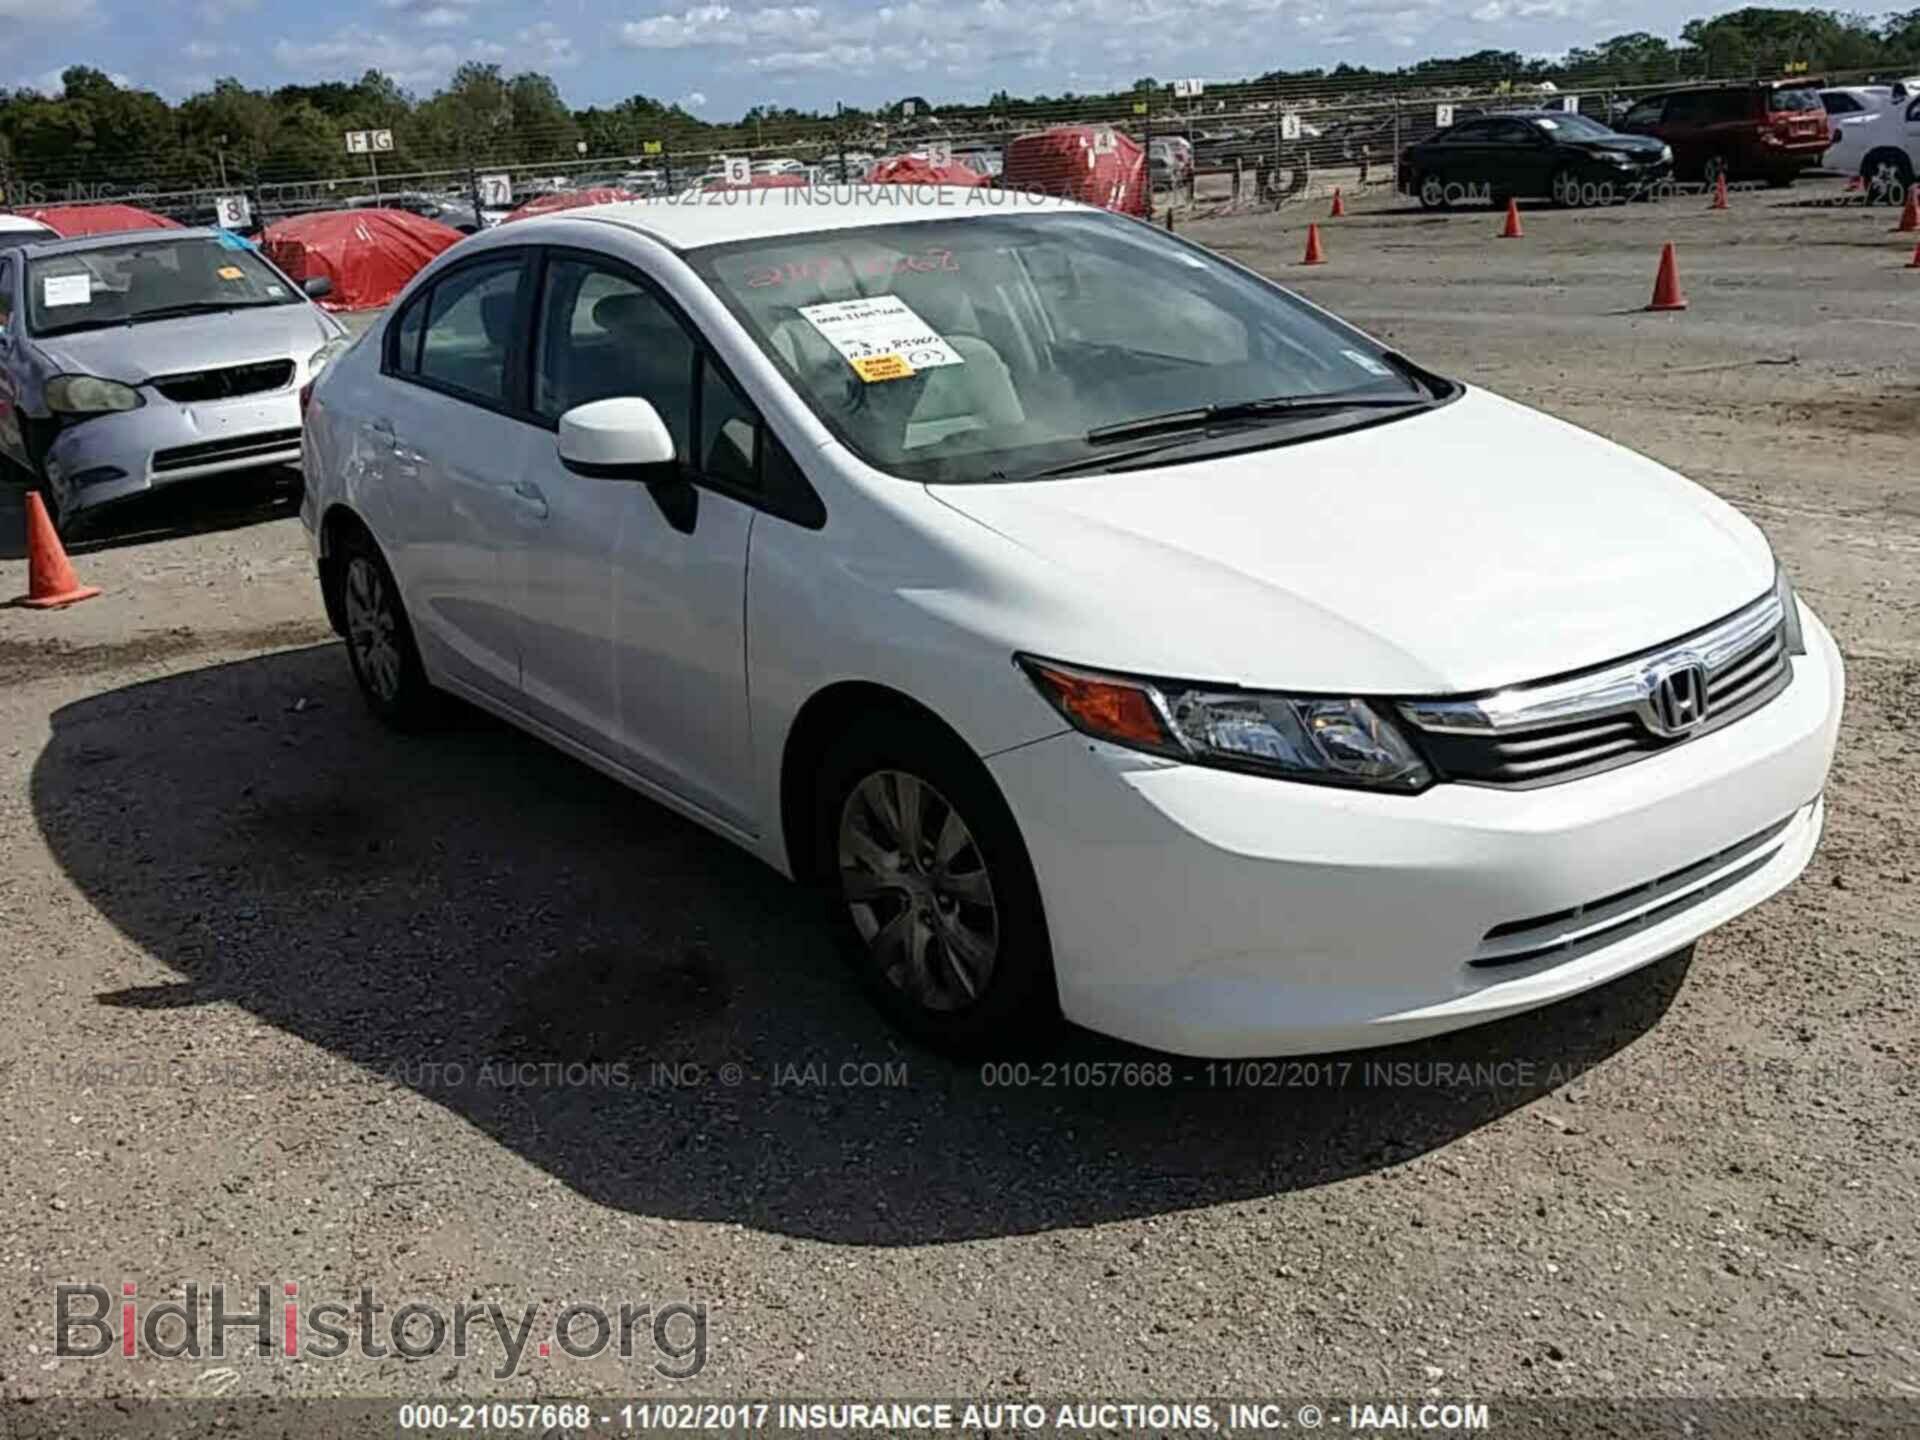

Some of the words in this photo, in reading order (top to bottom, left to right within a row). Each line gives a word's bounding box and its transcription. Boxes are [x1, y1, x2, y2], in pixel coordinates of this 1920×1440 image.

[350, 132, 362, 152] F
[375, 130, 391, 151] G
[731, 162, 744, 182] 6
[226, 201, 242, 223] 8
